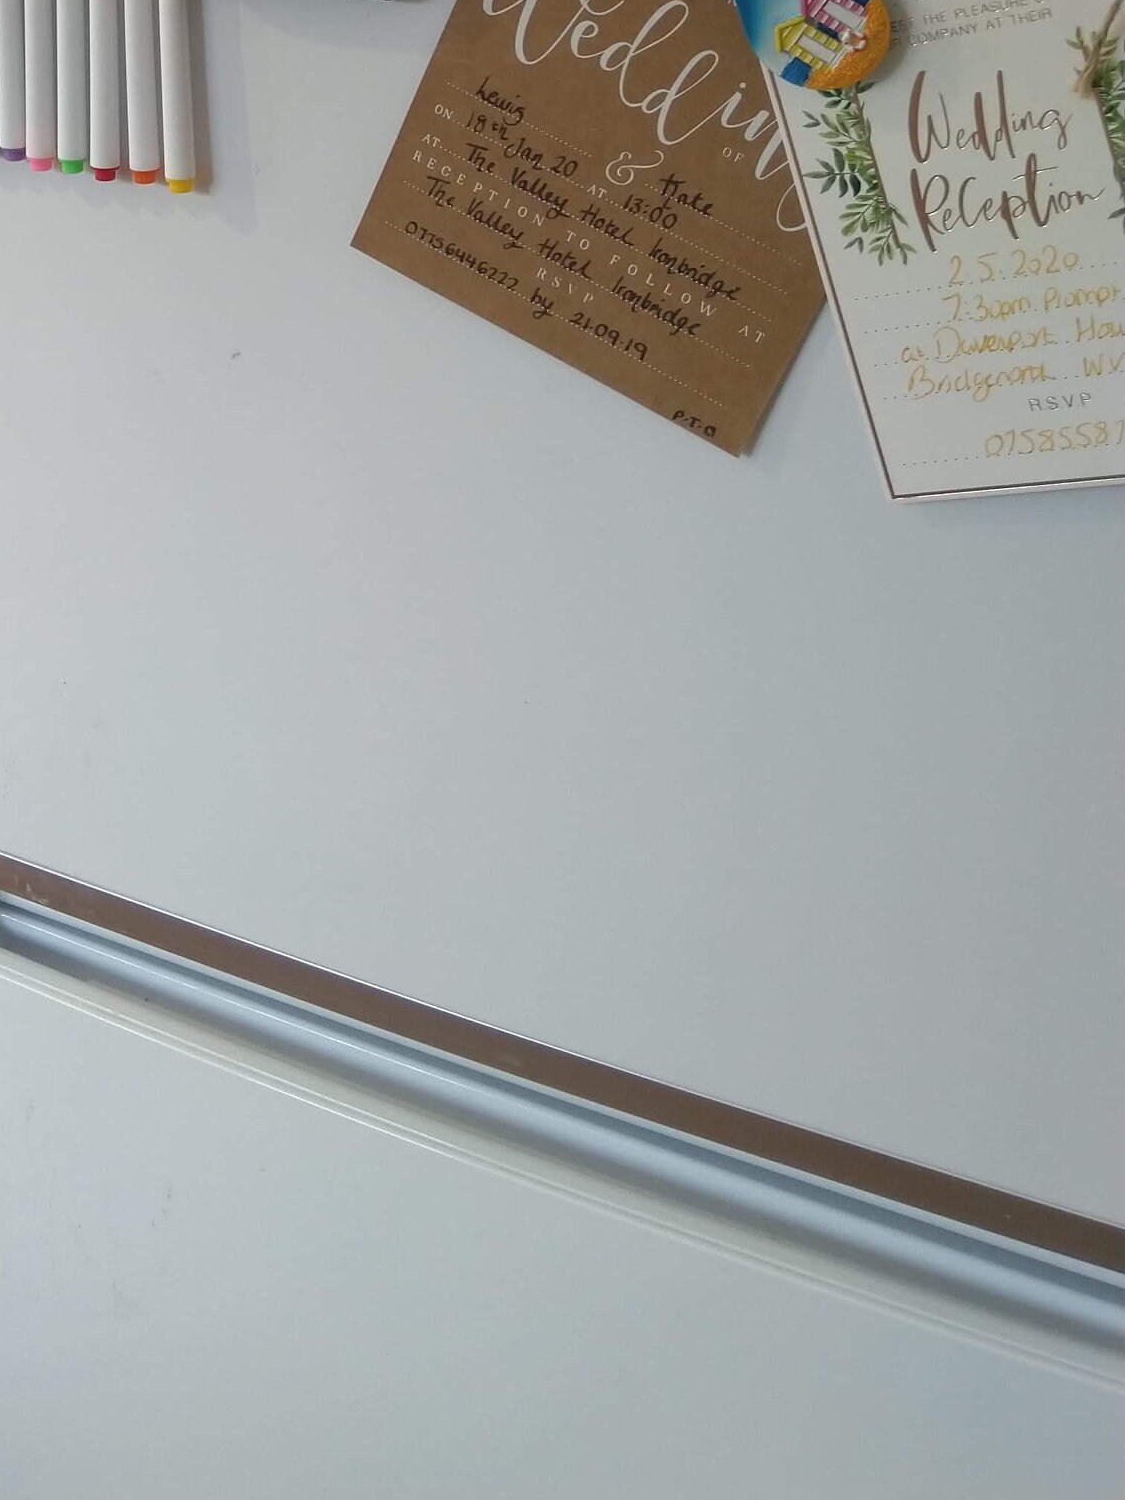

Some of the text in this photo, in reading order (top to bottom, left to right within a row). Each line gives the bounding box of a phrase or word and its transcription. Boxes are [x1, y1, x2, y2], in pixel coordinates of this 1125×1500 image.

[907, 22, 978, 47] COMPANY
[986, 16, 1004, 31] AT
[1010, 7, 1053, 26] THEIR
[923, 11, 948, 26] THE
[475, 75, 527, 126] Lewis
[605, 150, 665, 186] &
[722, 146, 745, 164] OF
[908, 69, 1073, 164] Wedding
[434, 104, 454, 120] ON
[504, 137, 544, 171] Jan
[550, 156, 578, 178] 20
[587, 184, 607, 199] AT
[623, 193, 678, 230] 13:00
[910, 153, 1106, 252] Reception
[412, 149, 765, 344] RECEPTION TO FOLLOW AT
[422, 133, 741, 301] AT The Valley Hotel Ironbridge
[426, 176, 701, 337] The Valley Hotel Ironbridge
[530, 287, 554, 319] by
